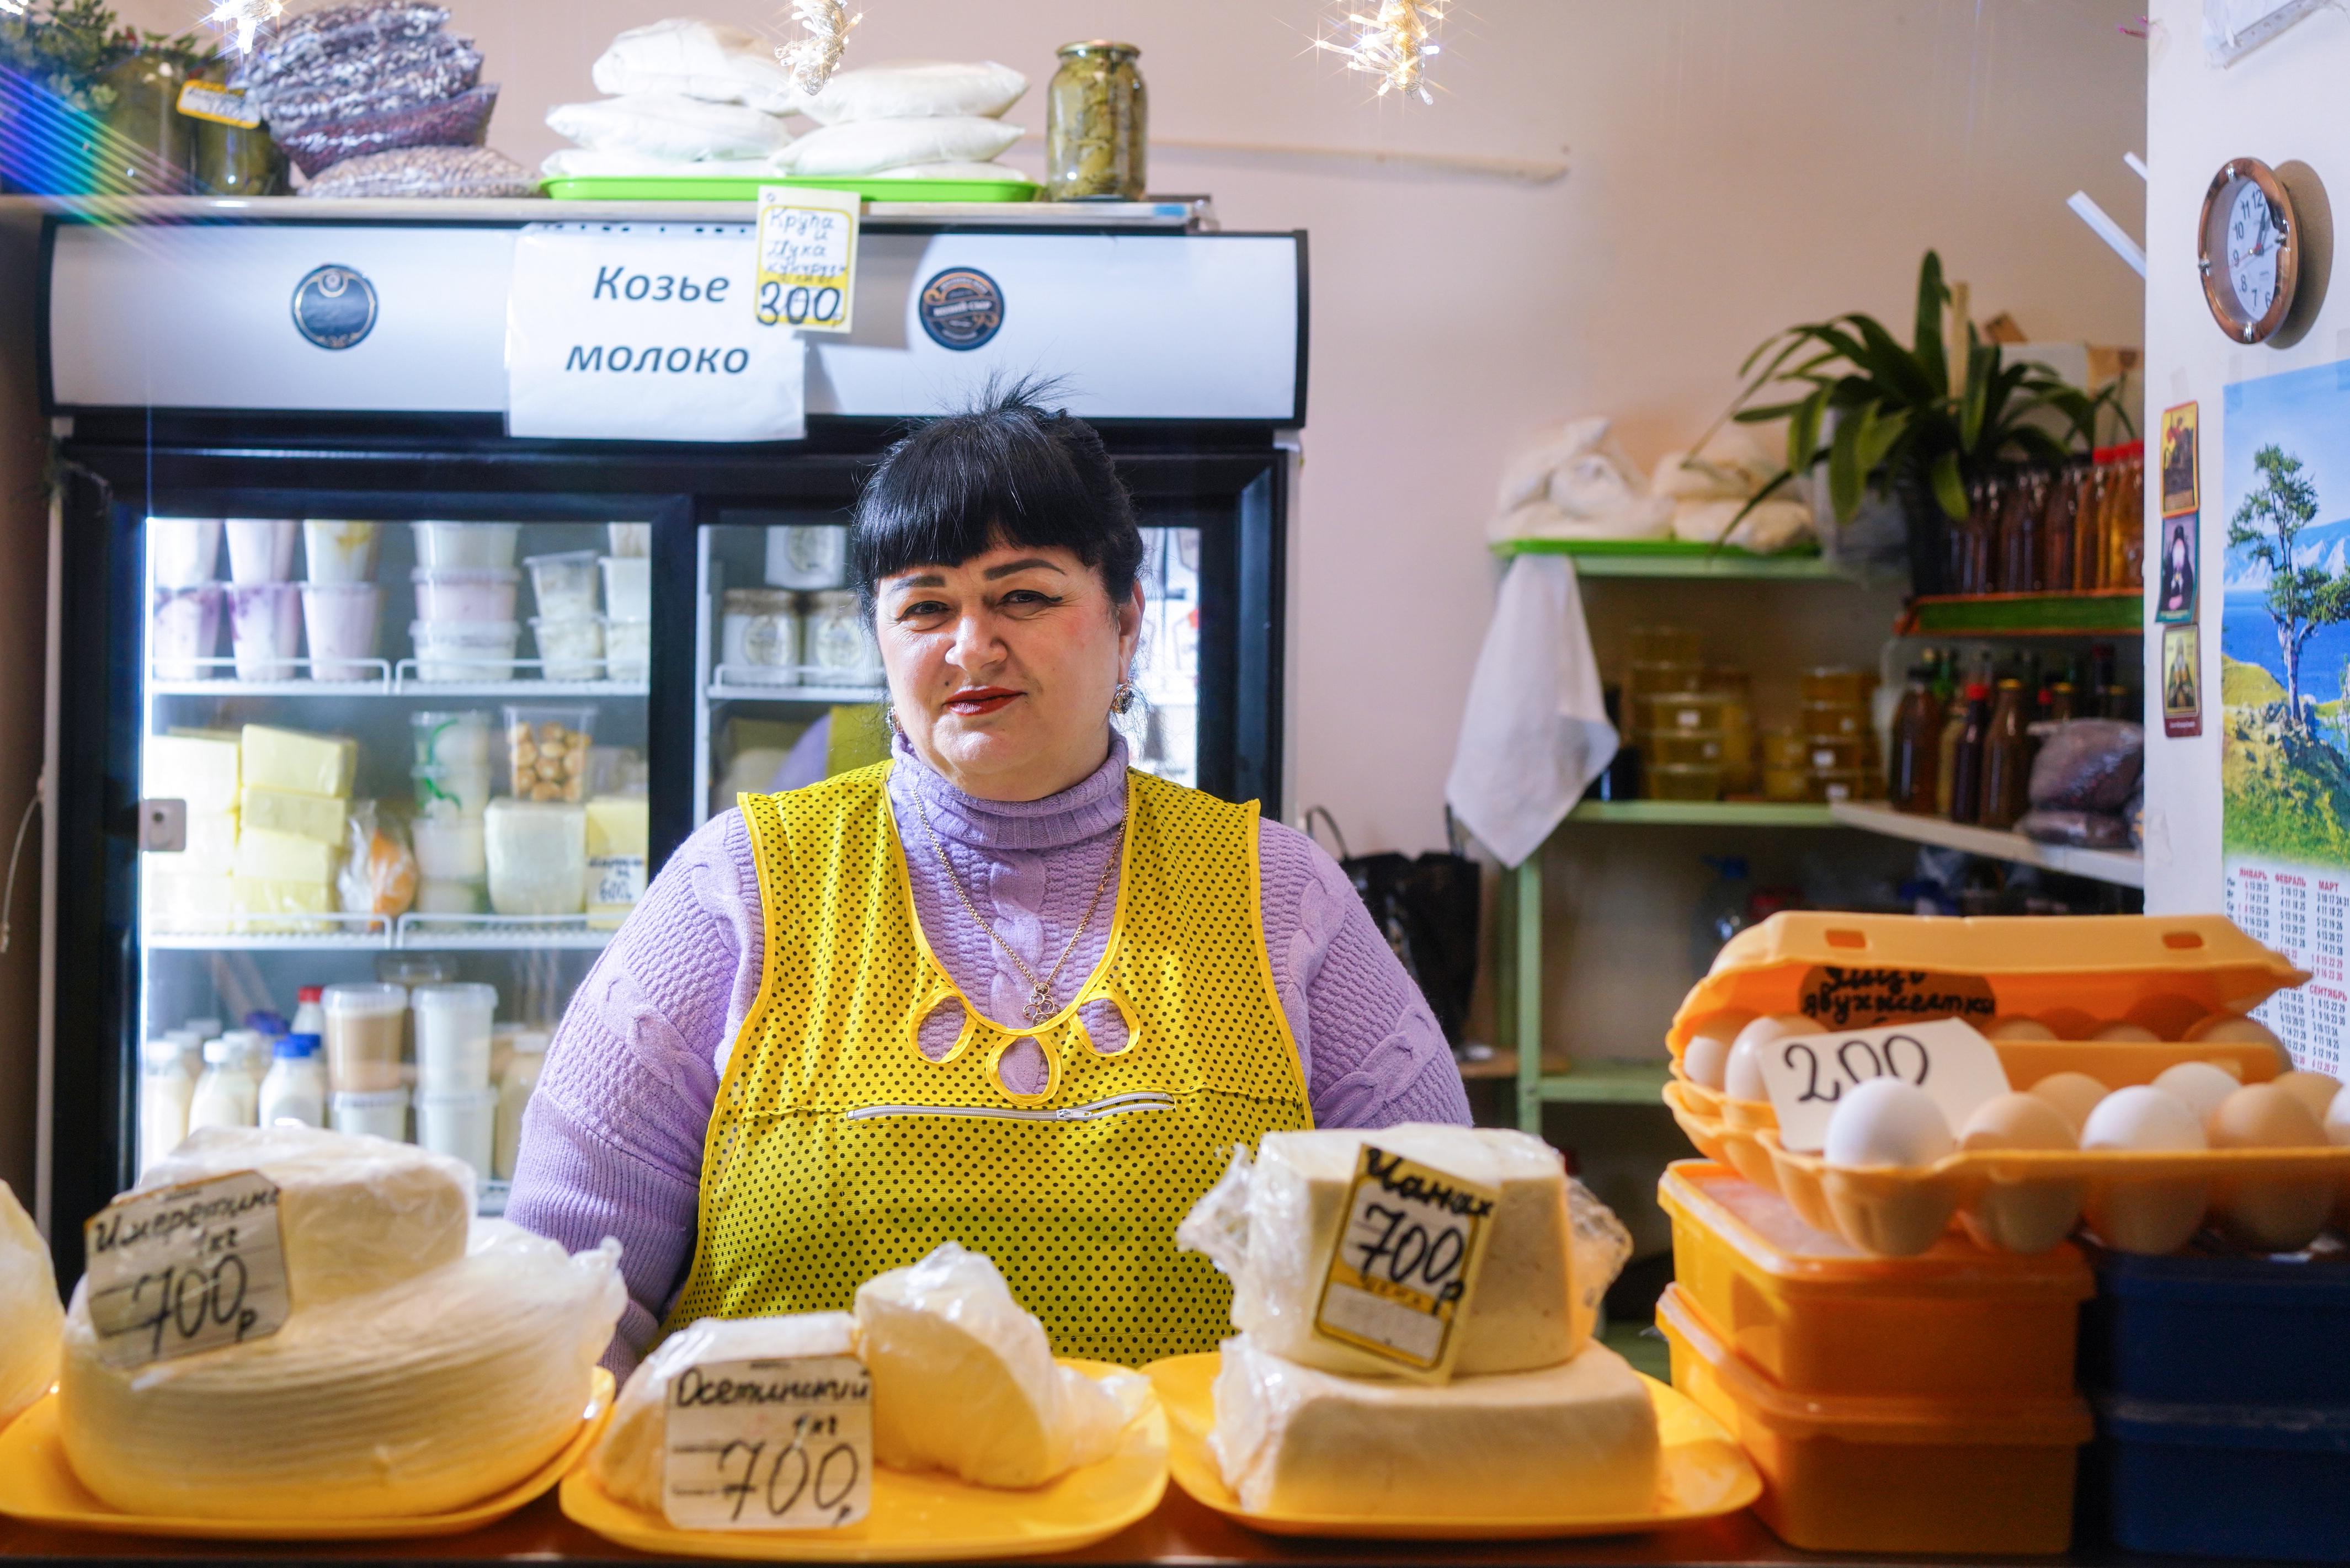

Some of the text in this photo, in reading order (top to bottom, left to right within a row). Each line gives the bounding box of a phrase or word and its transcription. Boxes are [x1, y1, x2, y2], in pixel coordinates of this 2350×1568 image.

[2252, 190, 2263, 208] 12
[2241, 200, 2250, 220] 11
[769, 206, 835, 237] Крупа
[2233, 221, 2244, 240] 10
[2233, 250, 2239, 266] 9
[593, 265, 730, 303] Козье
[2241, 275, 2247, 292] 8
[2252, 289, 2257, 307] 7
[564, 346, 750, 374] молоко
[2239, 867, 2267, 881] ЯНВАРЬ
[2275, 873, 2306, 888] ФЕВРАЛЬ
[2285, 886, 2291, 897] 10
[2293, 887, 2298, 897] 17
[2300, 888, 2305, 899] 24
[2319, 879, 2339, 893] МАРТ
[2285, 898, 2290, 908] 11
[2293, 899, 2298, 910] 18
[2300, 900, 2305, 911] 25
[2322, 893, 2327, 903] 10
[2329, 894, 2335, 904] 17
[2336, 895, 2342, 905] 24
[2343, 896, 2349, 907] 31
[2285, 910, 2290, 921] 12
[2293, 912, 2298, 922] 19
[2300, 914, 2305, 924] 26
[2322, 905, 2327, 915] 11
[2330, 906, 2335, 917] 18
[2337, 908, 2343, 918] 25
[2285, 922, 2291, 934] 13
[2293, 924, 2298, 935] 20
[2300, 925, 2305, 936] 27
[2322, 917, 2327, 929] 12
[2329, 919, 2335, 930] 19
[2336, 920, 2343, 931] 26
[2285, 935, 2290, 945] 14
[2292, 936, 2296, 947] 21
[2300, 937, 2305, 948] 28
[2322, 930, 2327, 941] 13
[2329, 931, 2335, 942] 20
[2336, 932, 2343, 943] 27
[2322, 942, 2327, 953] 14
[2329, 944, 2335, 954] 21
[2337, 945, 2343, 956] 28
[2321, 954, 2327, 966] 15
[2329, 956, 2335, 967] 22
[2337, 958, 2343, 969] 29
[2321, 968, 2327, 979] 16
[2328, 969, 2335, 980] 23
[2337, 970, 2342, 982] 30
[2284, 990, 2289, 1000] 11
[2291, 991, 2296, 1002] 18
[2298, 993, 2304, 1004] 25
[2309, 984, 2347, 1002] СЕНТЯБРЬ
[2284, 1001, 2289, 1012] 12
[2290, 1003, 2296, 1014] 19
[2298, 1004, 2304, 1016] 26
[2324, 999, 2329, 1010] 15
[2331, 1001, 2337, 1012] 22
[2339, 1002, 2345, 1014] 29
[2293, 1015, 2298, 1026] 20
[2299, 1017, 2305, 1027] 27
[2324, 1011, 2329, 1023] 16
[2331, 1013, 2337, 1025] 23
[2340, 1014, 2346, 1026] 30
[2287, 1026, 2292, 1036] 14
[2293, 1027, 2298, 1038] 21
[2317, 1022, 2323, 1033] 10
[2325, 1024, 2330, 1035] 17
[2331, 1026, 2338, 1037] 24
[2293, 1039, 2298, 1051] 22
[2300, 1042, 2305, 1053] 29
[2319, 1034, 2324, 1046] 11
[2326, 1036, 2331, 1048] 18
[2333, 1038, 2339, 1050] 25
[2318, 1047, 2324, 1058] 12
[2326, 1049, 2331, 1060] 19
[2333, 1051, 2339, 1063] 26
[1783, 1033, 1928, 1102] 200
[2324, 1062, 2330, 1072] 20
[2331, 1064, 2338, 1075] 27
